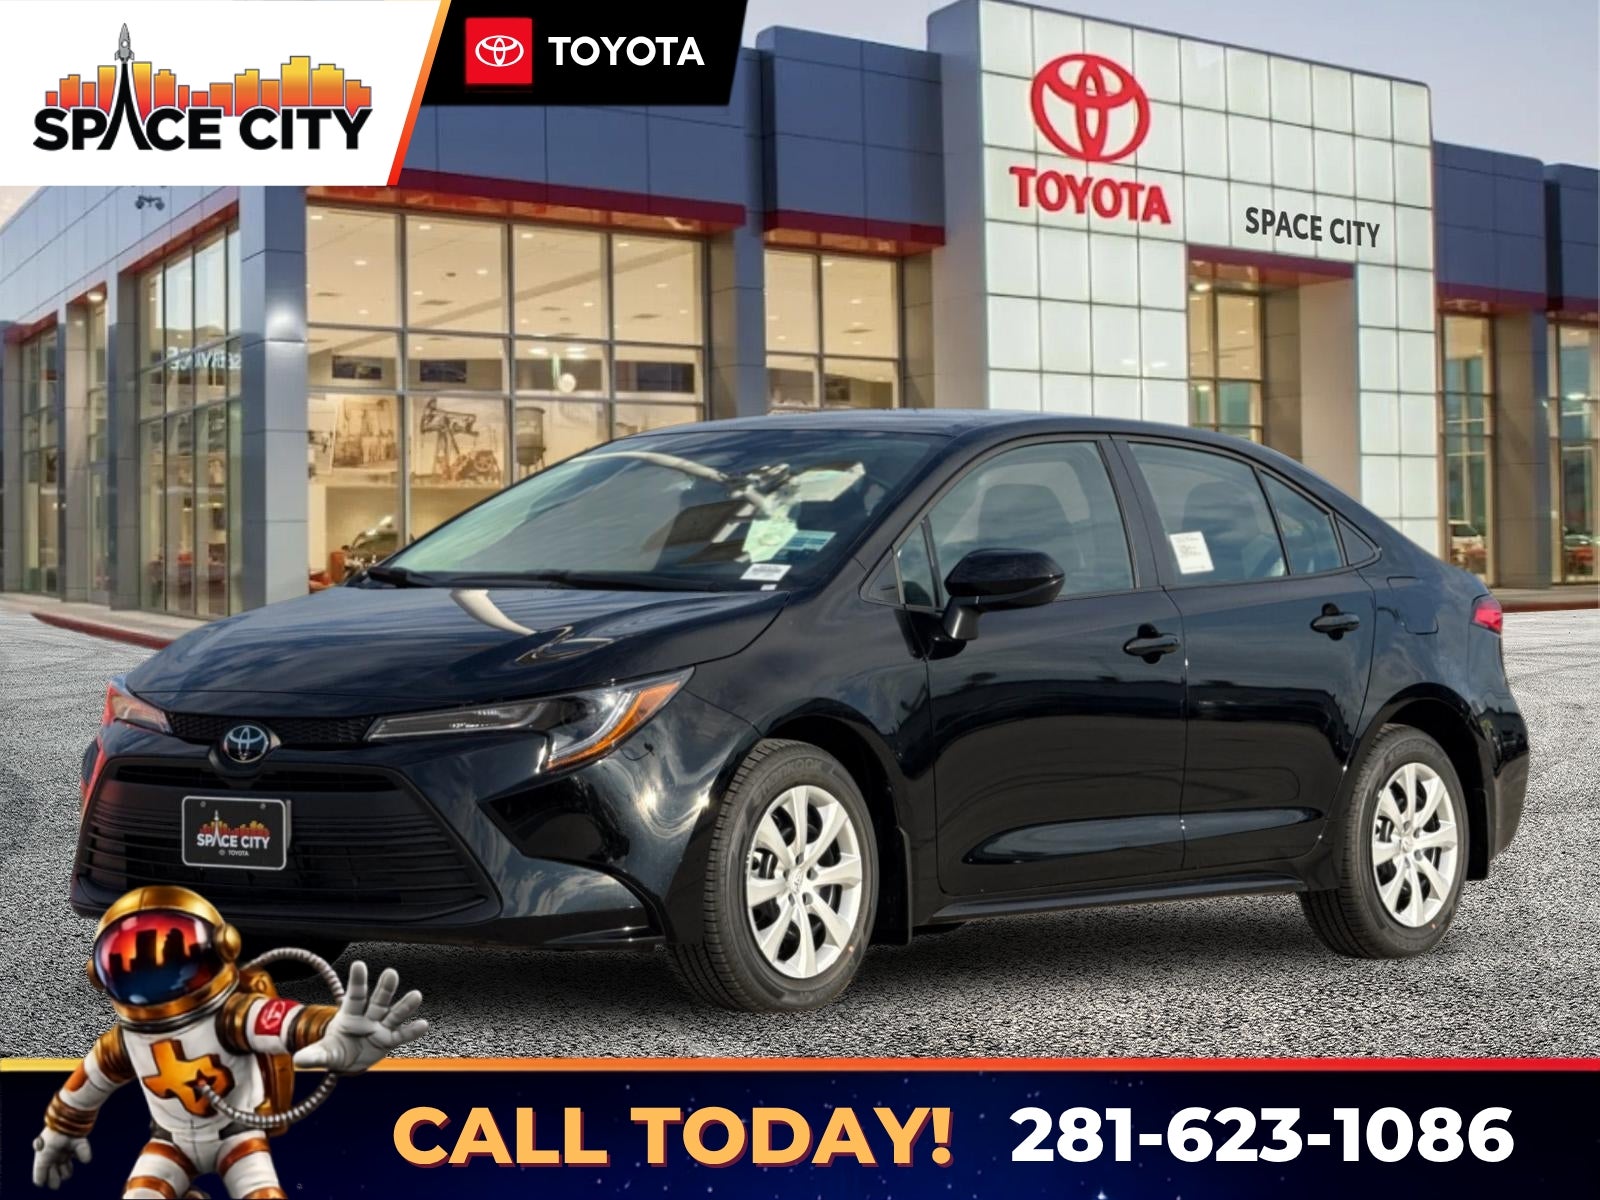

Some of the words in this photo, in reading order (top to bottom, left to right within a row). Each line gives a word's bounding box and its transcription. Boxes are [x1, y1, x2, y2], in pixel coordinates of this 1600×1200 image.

[1009, 166, 1171, 225] TOYOTA
[1245, 206, 1322, 242] SPACE
[1329, 218, 1380, 248] CITY
[196, 831, 237, 848] SPACE
[240, 835, 271, 849] CITY
[227, 849, 250, 858] TOYOTA
